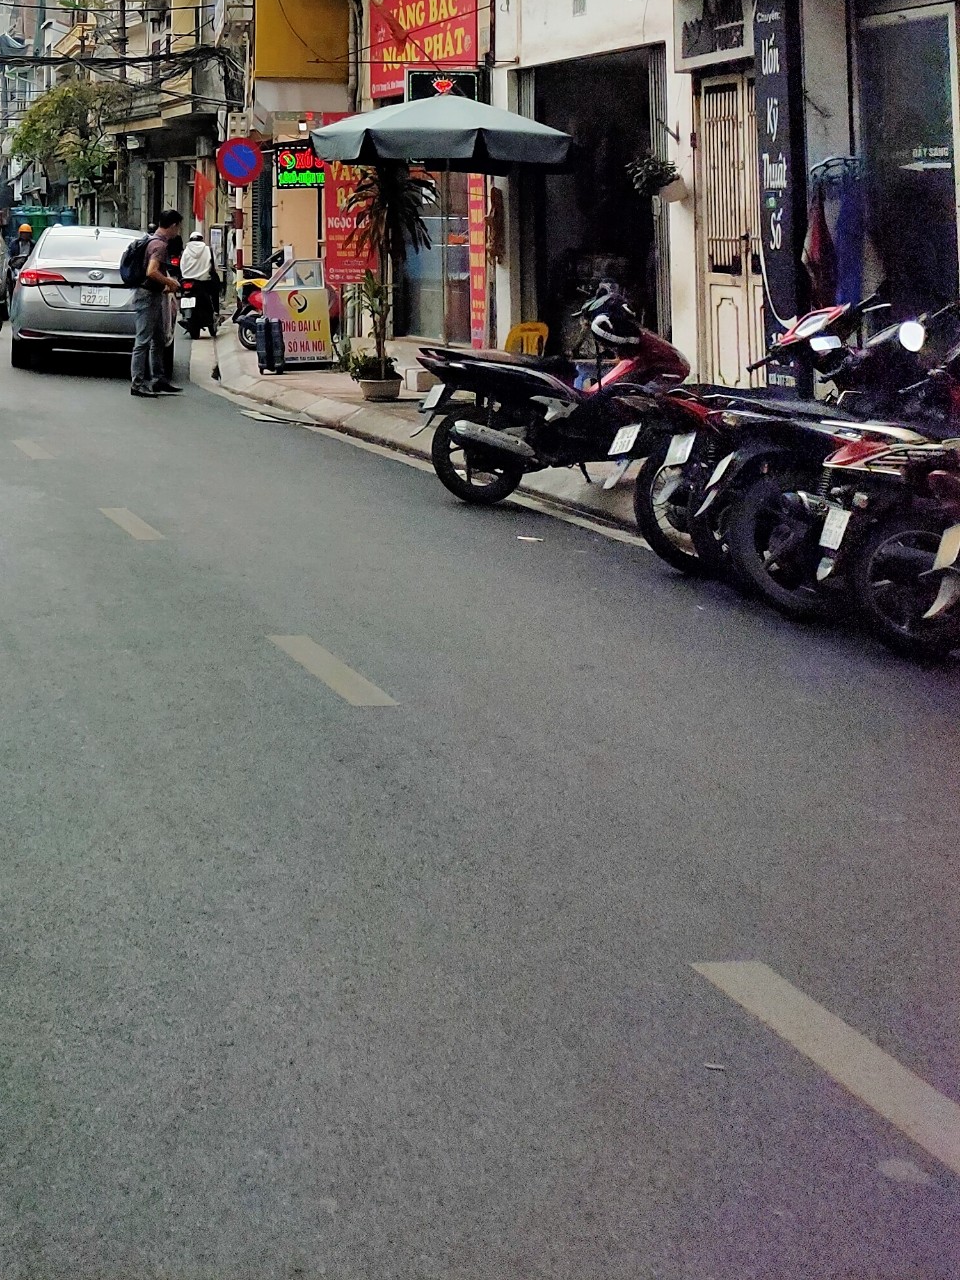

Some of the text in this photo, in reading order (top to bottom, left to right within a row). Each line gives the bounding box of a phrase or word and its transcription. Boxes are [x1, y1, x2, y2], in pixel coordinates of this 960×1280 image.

[423, 22, 465, 61] PHÁT
[760, 33, 780, 76] Uốn
[766, 96, 779, 142] Kỹ
[762, 153, 787, 198] Thuật
[327, 216, 352, 231] NGỌC
[769, 208, 783, 251] Số
